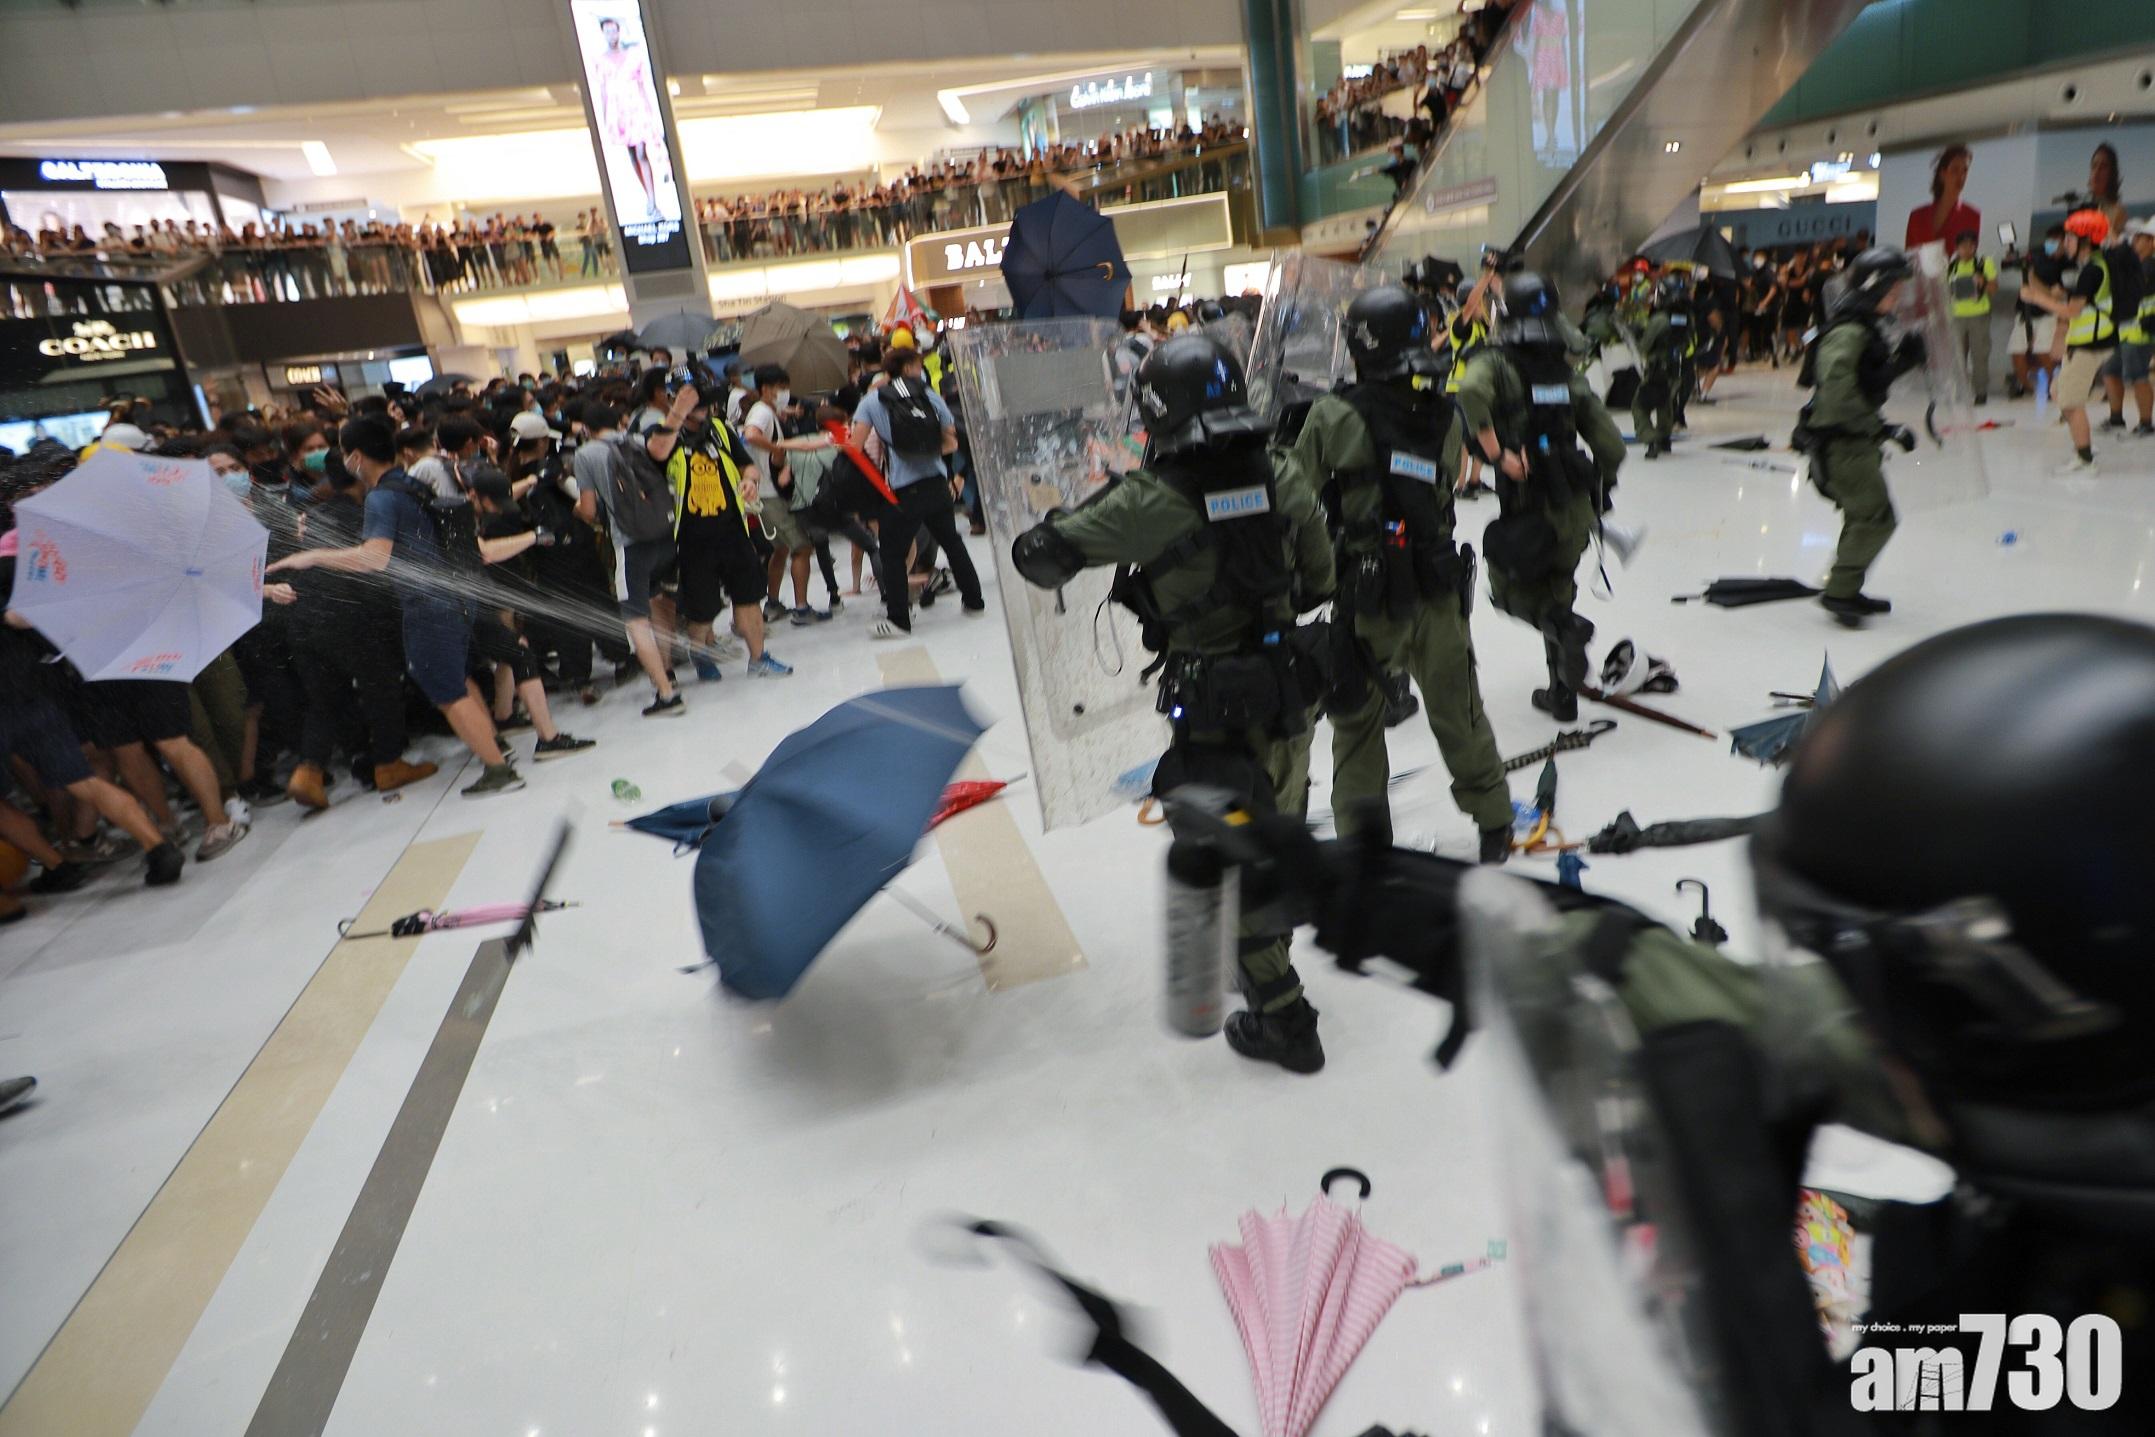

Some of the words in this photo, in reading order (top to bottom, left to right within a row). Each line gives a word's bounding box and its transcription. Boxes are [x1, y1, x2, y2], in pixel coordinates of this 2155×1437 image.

[1777, 214, 1851, 237] GUCCI
[38, 331, 157, 357] COACH
[1394, 455, 1433, 477] POLICE
[1209, 489, 1263, 513] POLICE
